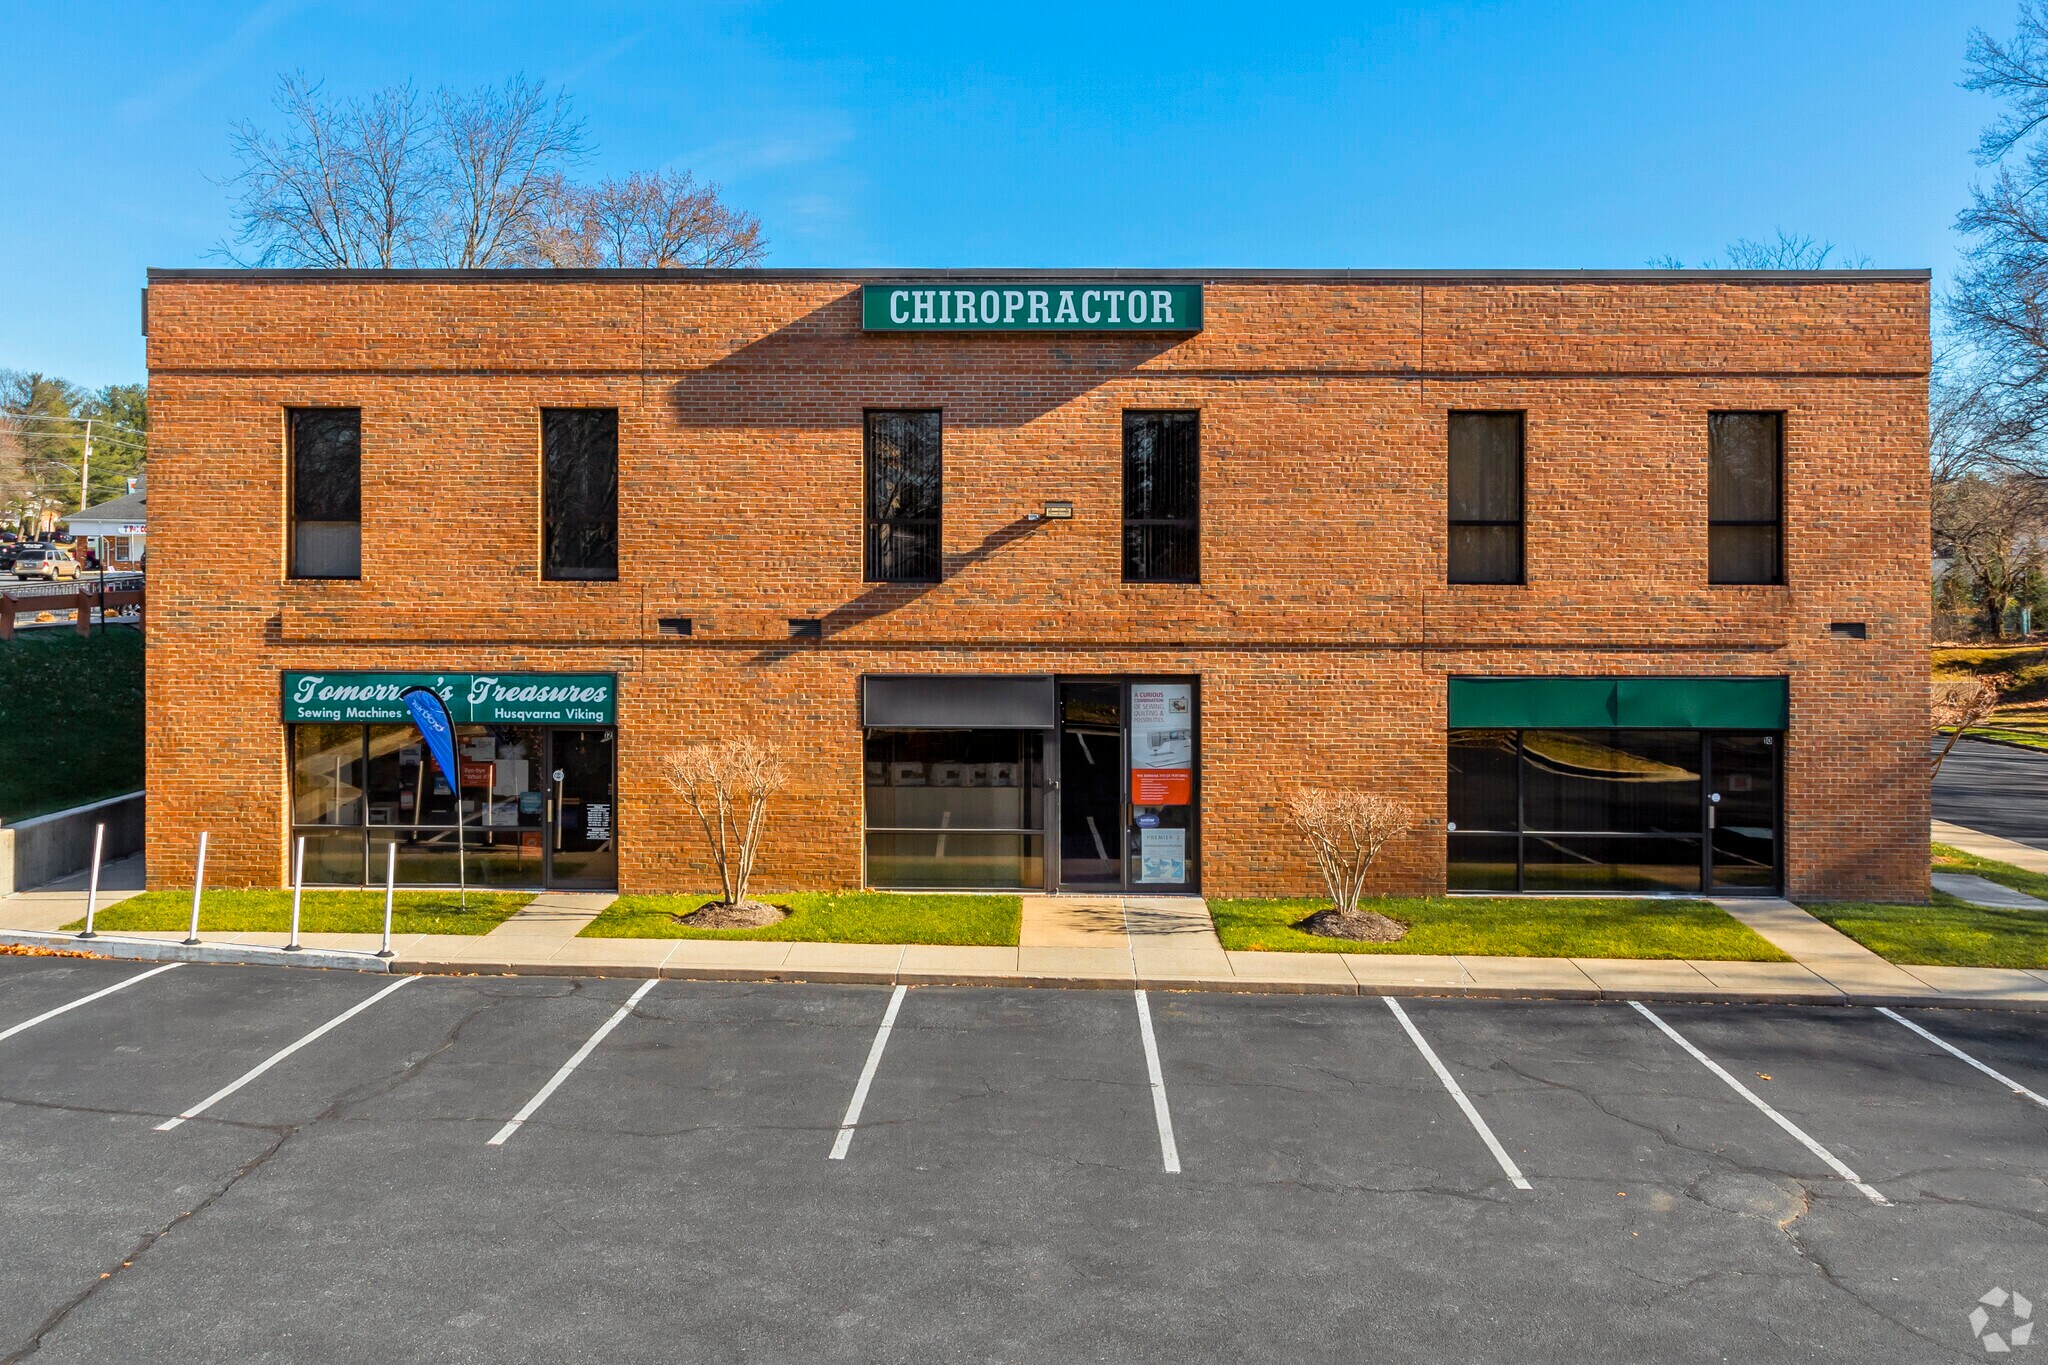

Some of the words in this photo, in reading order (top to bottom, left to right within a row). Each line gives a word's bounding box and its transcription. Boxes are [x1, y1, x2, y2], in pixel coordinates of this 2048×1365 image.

[889, 289, 1175, 324] CHIROPRACTOR
[293, 675, 454, 704] Tomorr's
[467, 676, 608, 705] Treasures
[297, 706, 341, 721] Sewing
[346, 706, 402, 718] Machines
[494, 707, 561, 721] Husqvarna
[565, 708, 604, 722] Viking
